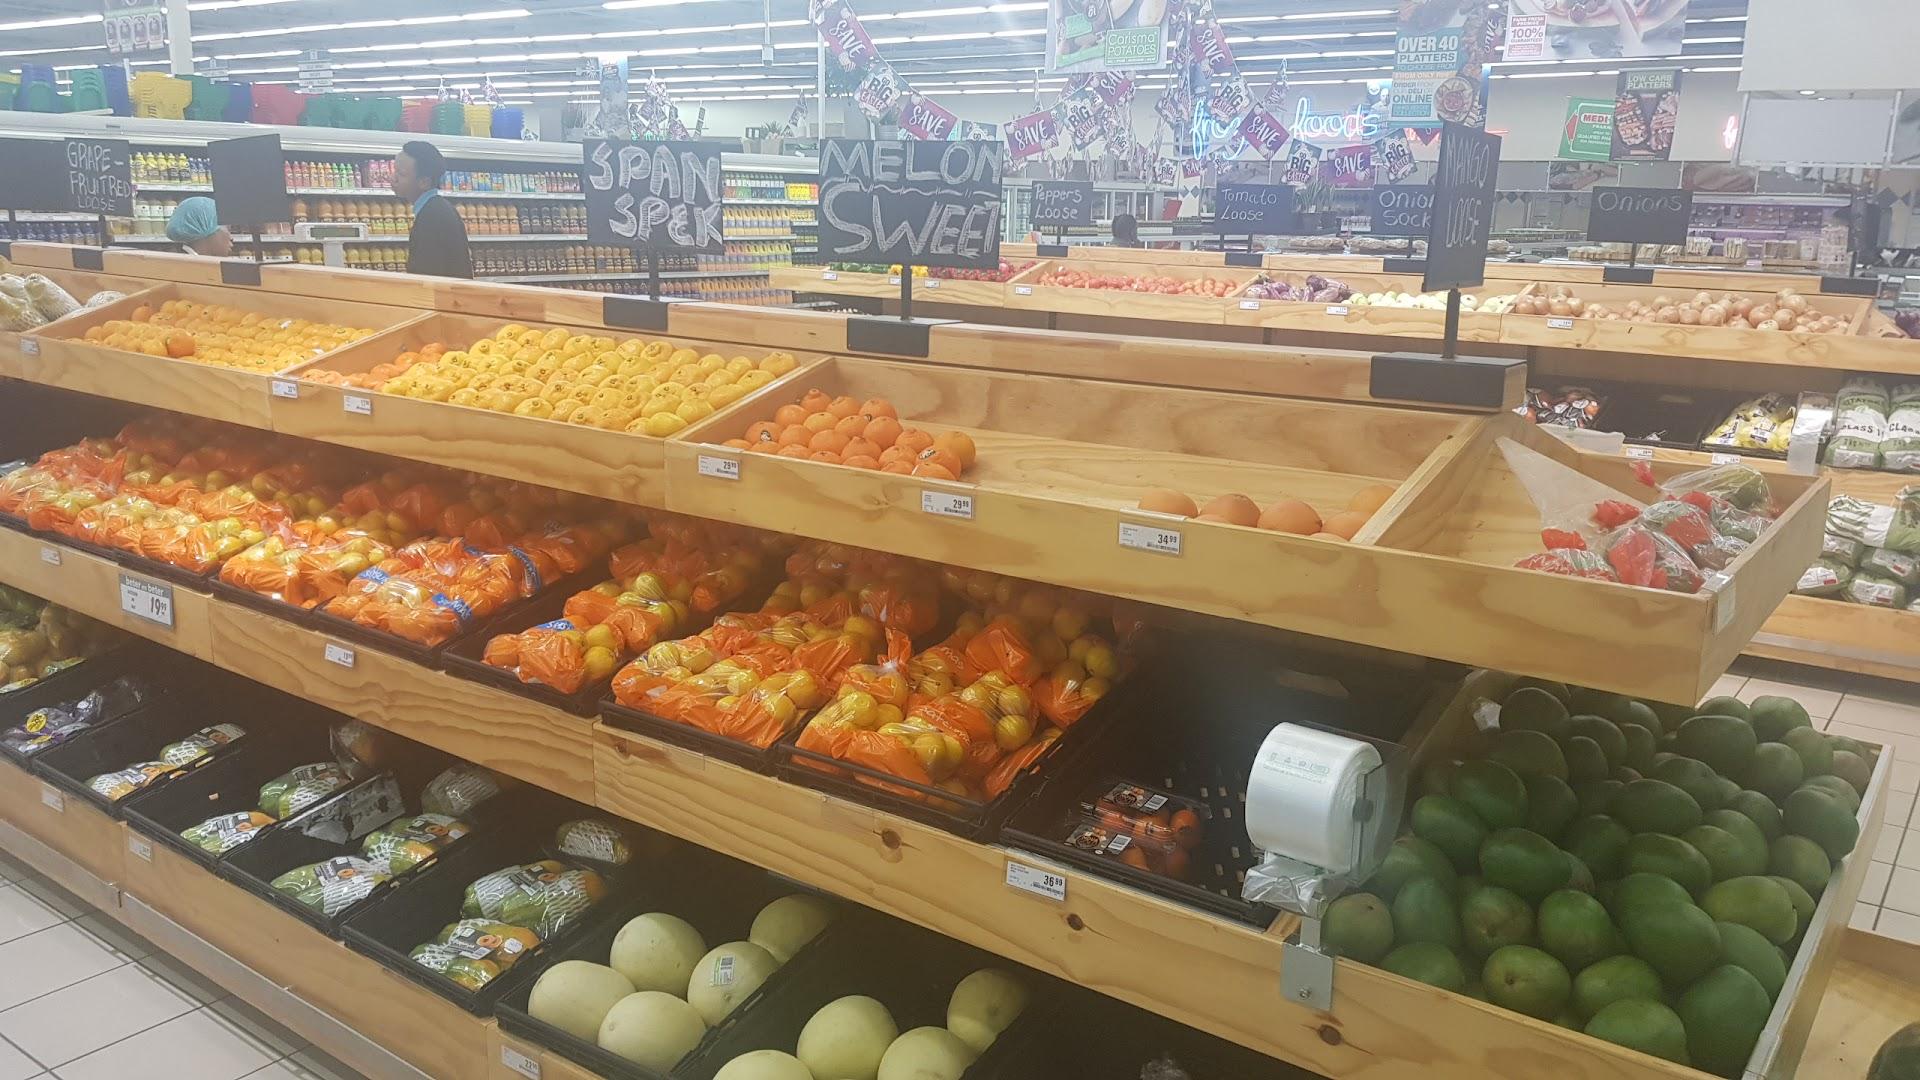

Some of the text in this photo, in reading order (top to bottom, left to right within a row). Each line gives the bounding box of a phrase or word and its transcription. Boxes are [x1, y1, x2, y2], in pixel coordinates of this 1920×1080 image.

[829, 20, 865, 58] SAVE
[1108, 31, 1155, 45] Carisma
[1398, 35, 1459, 52] OVER 40
[1511, 27, 1544, 38] 100%
[1108, 45, 1156, 56] POTATOES
[1197, 29, 1226, 66] SAVE
[1399, 52, 1456, 62] PLATTERS
[868, 77, 893, 101] BIG
[1221, 84, 1243, 108] BIG
[1627, 81, 1672, 89] PLATTERS
[1392, 94, 1433, 103] ONLINE
[909, 105, 947, 136] SAVE
[1068, 105, 1091, 128] BIG
[1288, 96, 1381, 143] foods
[1014, 120, 1048, 151] SAVE
[1247, 115, 1281, 147] SAVE
[819, 139, 1004, 185] MELON
[1290, 156, 1312, 172] BIG
[1334, 152, 1364, 177] SAVE
[1385, 144, 1407, 164] BIG
[1445, 132, 1490, 190] MANGO
[589, 142, 722, 205] SPAN
[77, 195, 116, 212] LOOSE
[1034, 183, 1083, 206] Peppers
[1220, 188, 1278, 205] Tomato
[1598, 191, 1682, 213] Onions
[609, 193, 723, 248] SPEK
[822, 182, 1001, 259] SWEET
[1034, 205, 1079, 220] Loose
[1220, 205, 1264, 222] Loose
[1445, 197, 1482, 249] LOOSE
